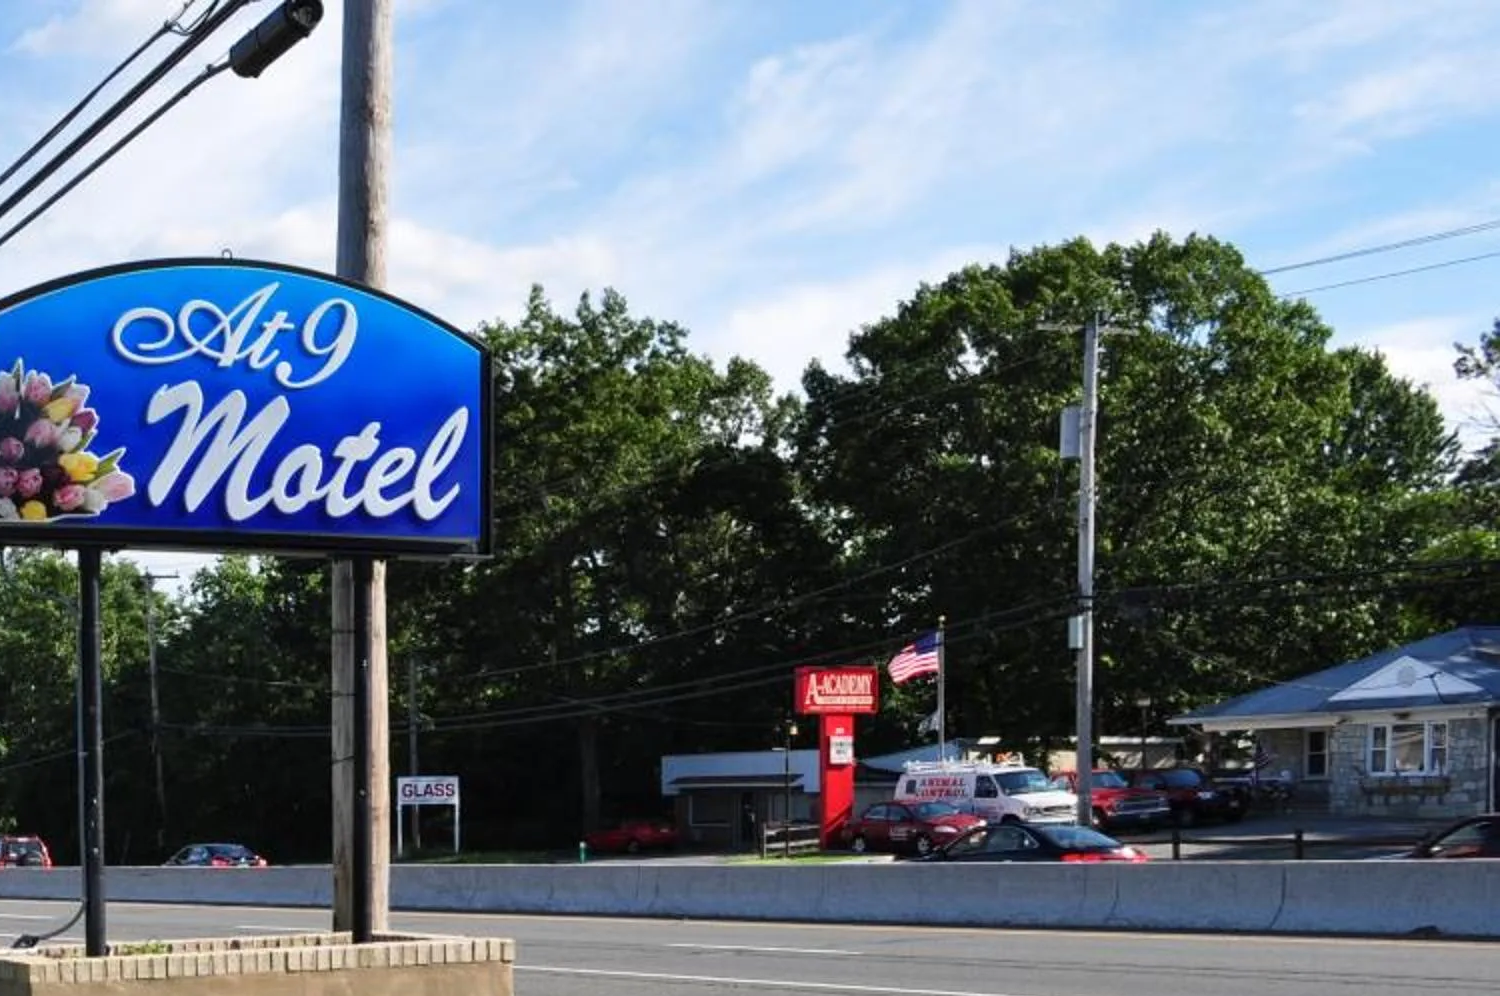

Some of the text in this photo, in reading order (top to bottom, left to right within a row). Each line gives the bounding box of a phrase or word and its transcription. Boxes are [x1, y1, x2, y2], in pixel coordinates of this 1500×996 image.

[112, 282, 358, 390] At 9
[147, 380, 469, 522] Motel
[402, 783, 455, 798] GLASS
